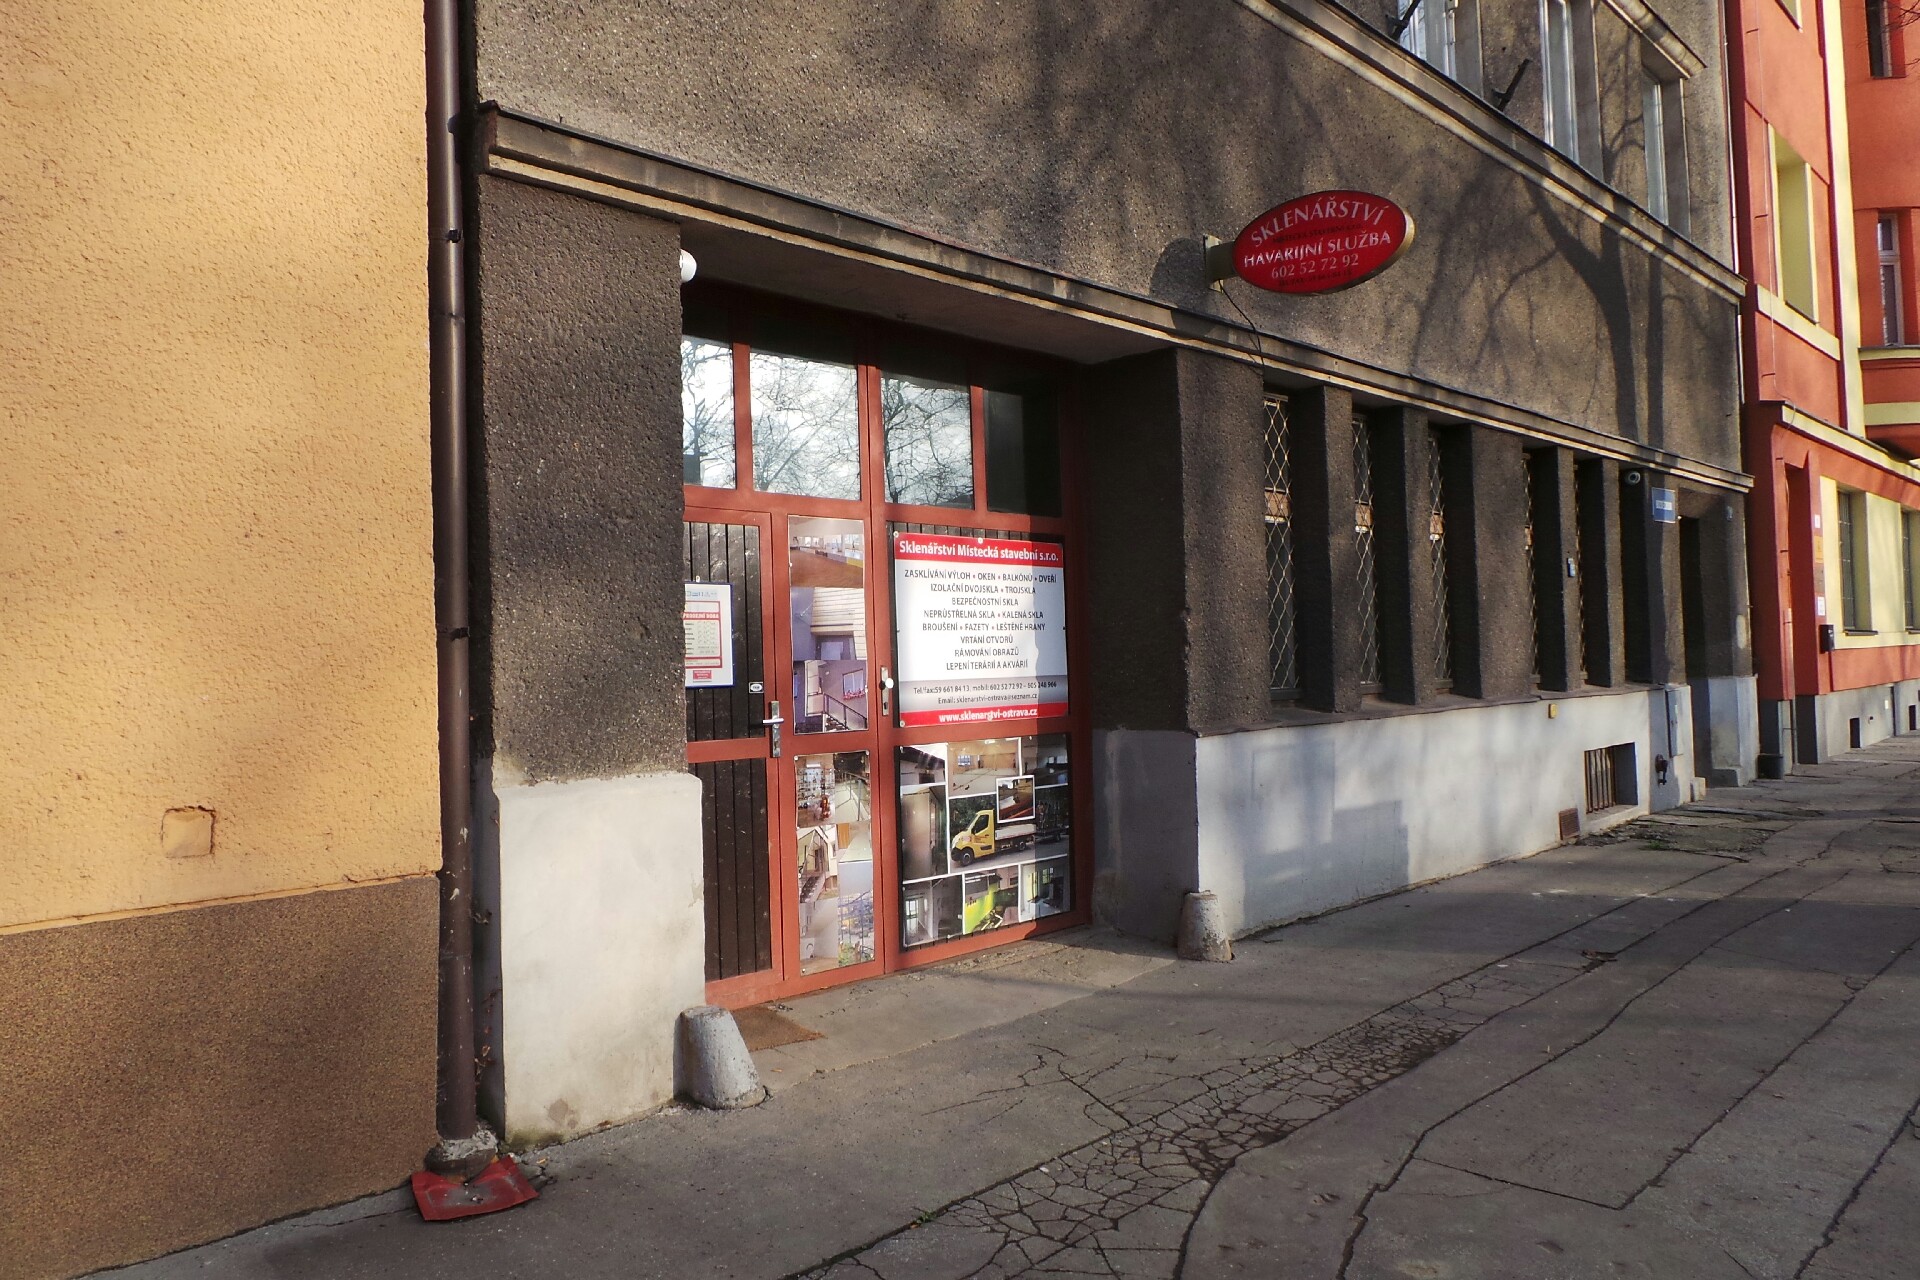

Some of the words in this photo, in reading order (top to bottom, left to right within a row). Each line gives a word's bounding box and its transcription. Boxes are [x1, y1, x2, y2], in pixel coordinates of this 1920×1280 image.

[1251, 196, 1389, 247] SKLENÁŘSTVÍ
[1244, 237, 1323, 268] HAVARIJNÍ
[1327, 230, 1391, 254] SLUŽBA
[1271, 264, 1295, 280] 602
[1300, 260, 1316, 276] 52
[1321, 257, 1337, 272] 72
[1342, 253, 1359, 267] 92
[899, 540, 956, 556] Sklenářství
[957, 544, 999, 559] Místecká
[1000, 548, 1038, 561] stavební
[1039, 552, 1059, 562] s.r.o.
[904, 568, 947, 580] ZASKLÍVÁNÍ
[947, 570, 971, 580] VÝLOH
[977, 572, 996, 581] OKEN
[1038, 573, 1057, 583] DVEŘÍ
[930, 583, 964, 593] IZOLAČNÍ
[964, 584, 999, 594] DVOJSKLA
[1005, 586, 1036, 594] TROJSKLA
[951, 596, 1002, 606] BEZPEČNOSTNÍ
[1002, 598, 1019, 606] SKLA
[923, 608, 977, 619] NEPRŮSTŘELNÁ
[978, 610, 995, 619] SKLA
[1001, 609, 1027, 619] KALENÁ
[1028, 611, 1044, 619] SKLA
[922, 621, 958, 631] BROUŠENÍ
[964, 623, 990, 631] FAZETY
[1024, 623, 1046, 631] HRANY
[960, 634, 985, 644] VRTÁNÍ
[985, 634, 1014, 644] OTVORŮ
[954, 647, 992, 657] RÁMOVÁNÍ
[992, 646, 1020, 656] OBRAZŮ
[946, 660, 970, 671] LEPENÍ
[996, 660, 1002, 669] A
[942, 685, 954, 693] 661
[954, 685, 961, 693] 84
[938, 708, 1038, 723] www.sklenarstvi-ostrava.cz
